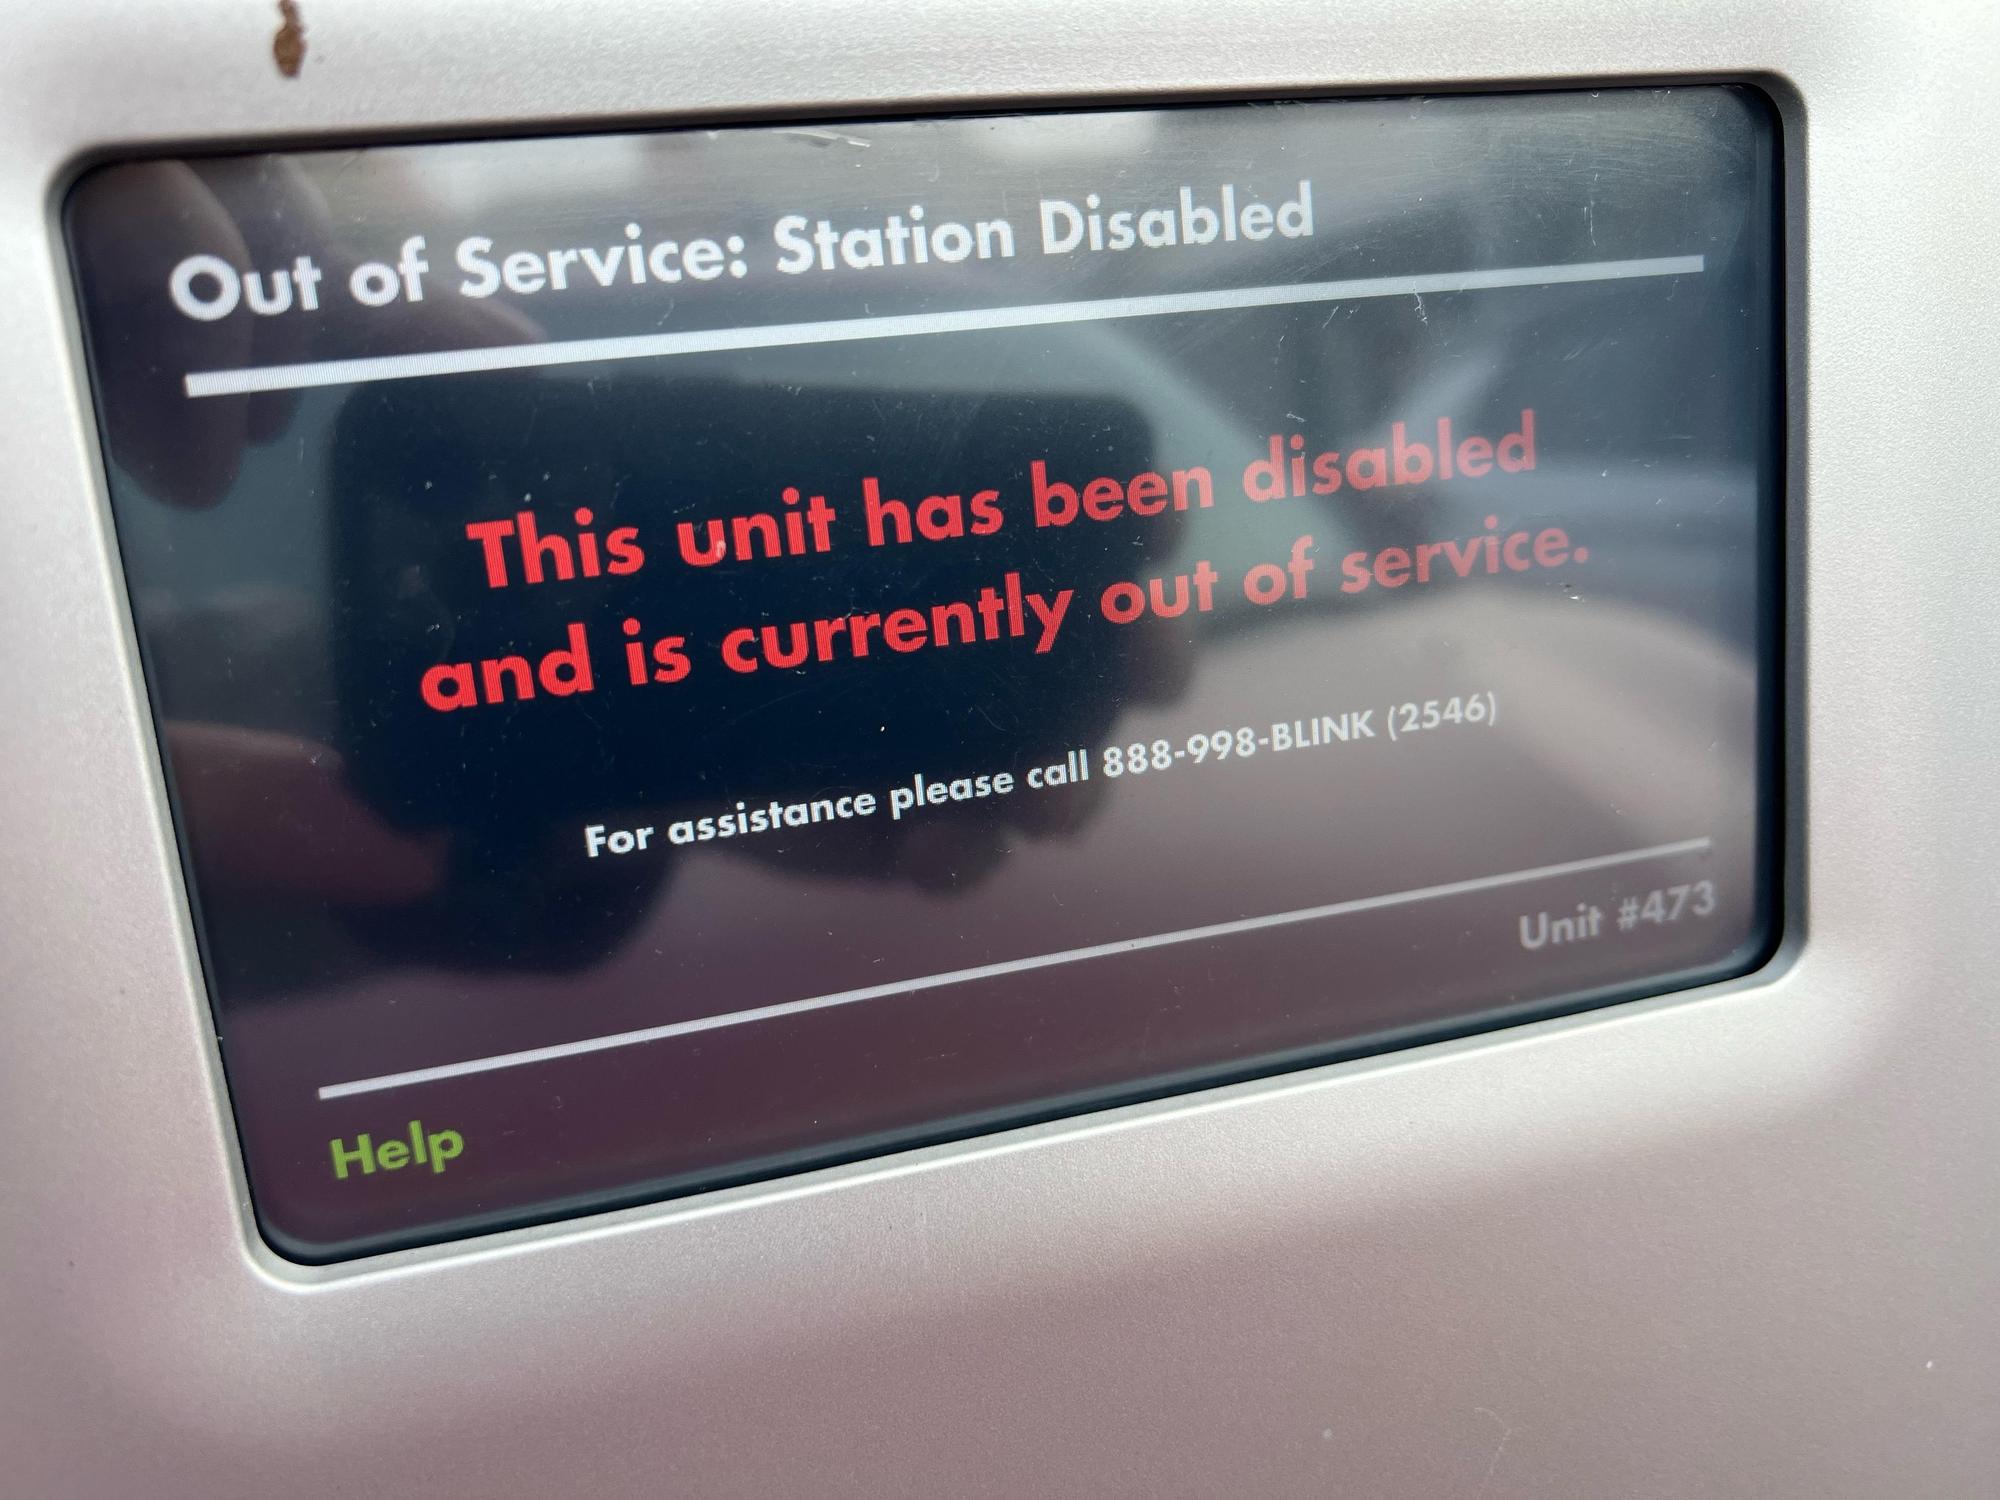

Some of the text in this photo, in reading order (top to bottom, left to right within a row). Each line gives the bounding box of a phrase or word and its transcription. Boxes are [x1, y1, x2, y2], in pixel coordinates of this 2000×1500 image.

[170, 180, 1314, 321] Out of Service: Station Disabled
[466, 409, 1537, 588] This unit has been disabled
[420, 515, 1590, 713] and is currently out of service.
[584, 691, 1499, 858] For assistance please call 888-998-BLINK (2546)
[1518, 879, 1716, 950] Unit #473
[330, 1120, 464, 1179] Help
